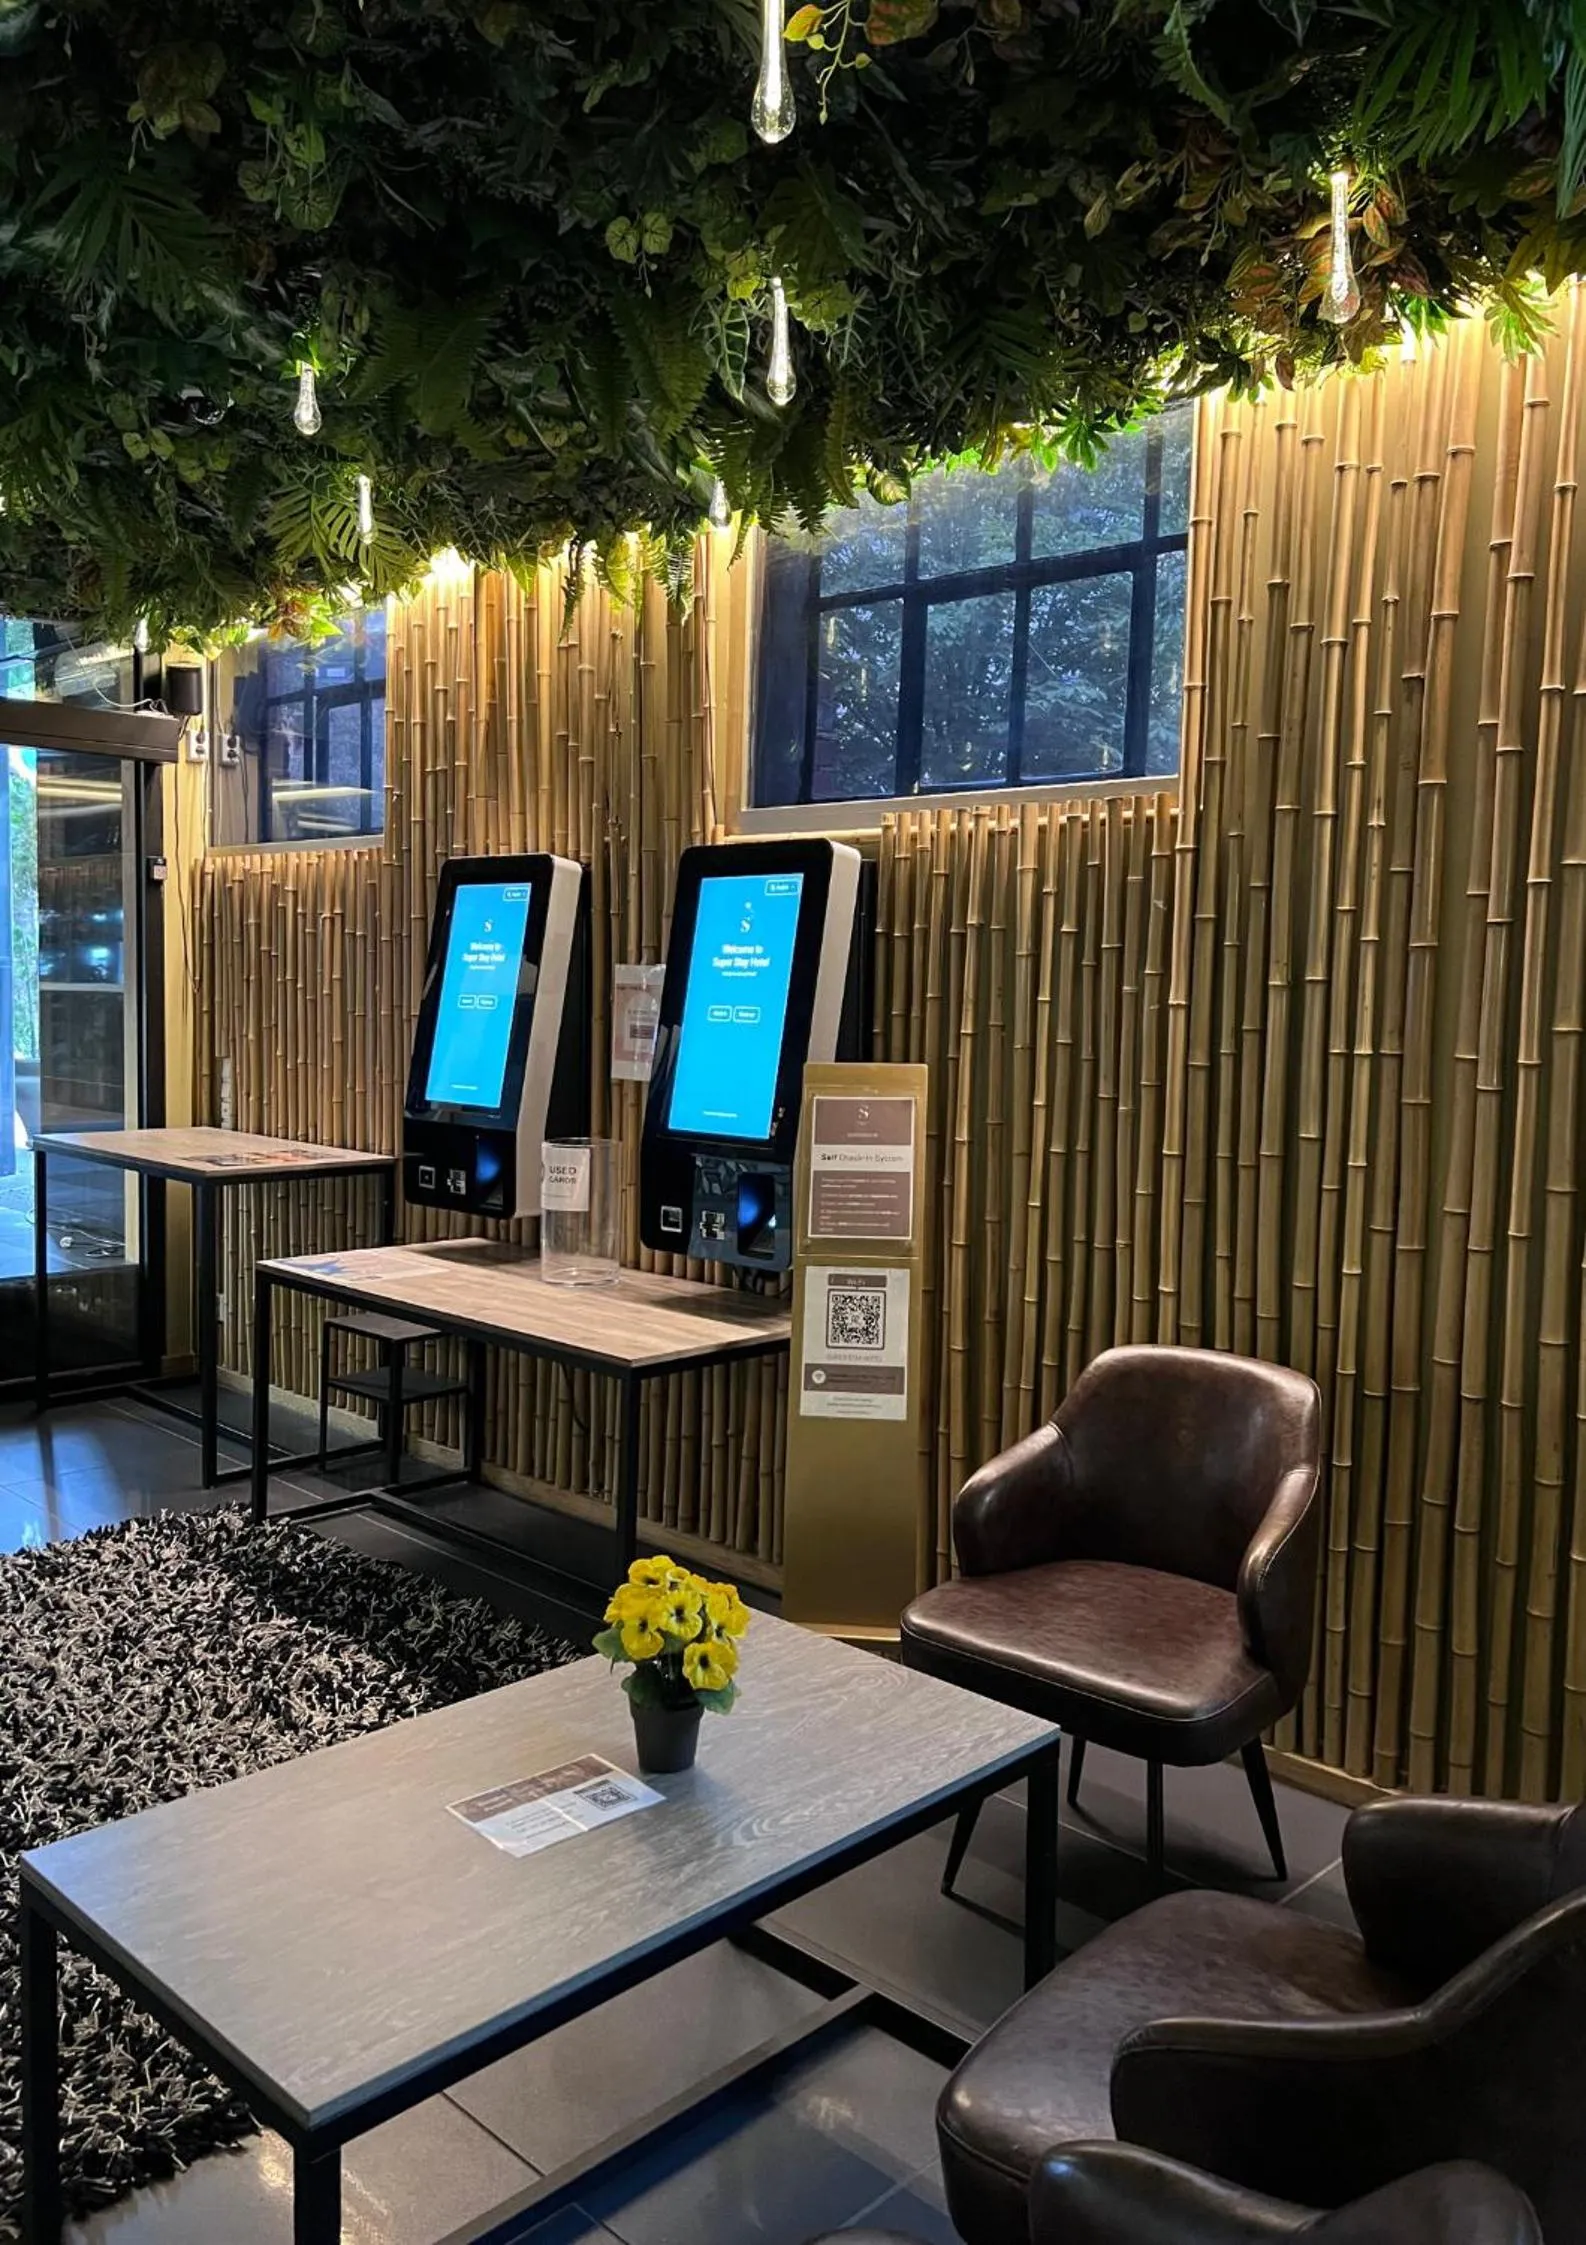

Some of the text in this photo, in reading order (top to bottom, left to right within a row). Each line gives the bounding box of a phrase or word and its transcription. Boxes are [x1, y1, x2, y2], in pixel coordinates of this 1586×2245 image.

[470, 942, 494, 951] Welcome
[722, 944, 764, 954] Welcome to
[820, 1152, 838, 1161] Self
[548, 1165, 577, 1175] USED
